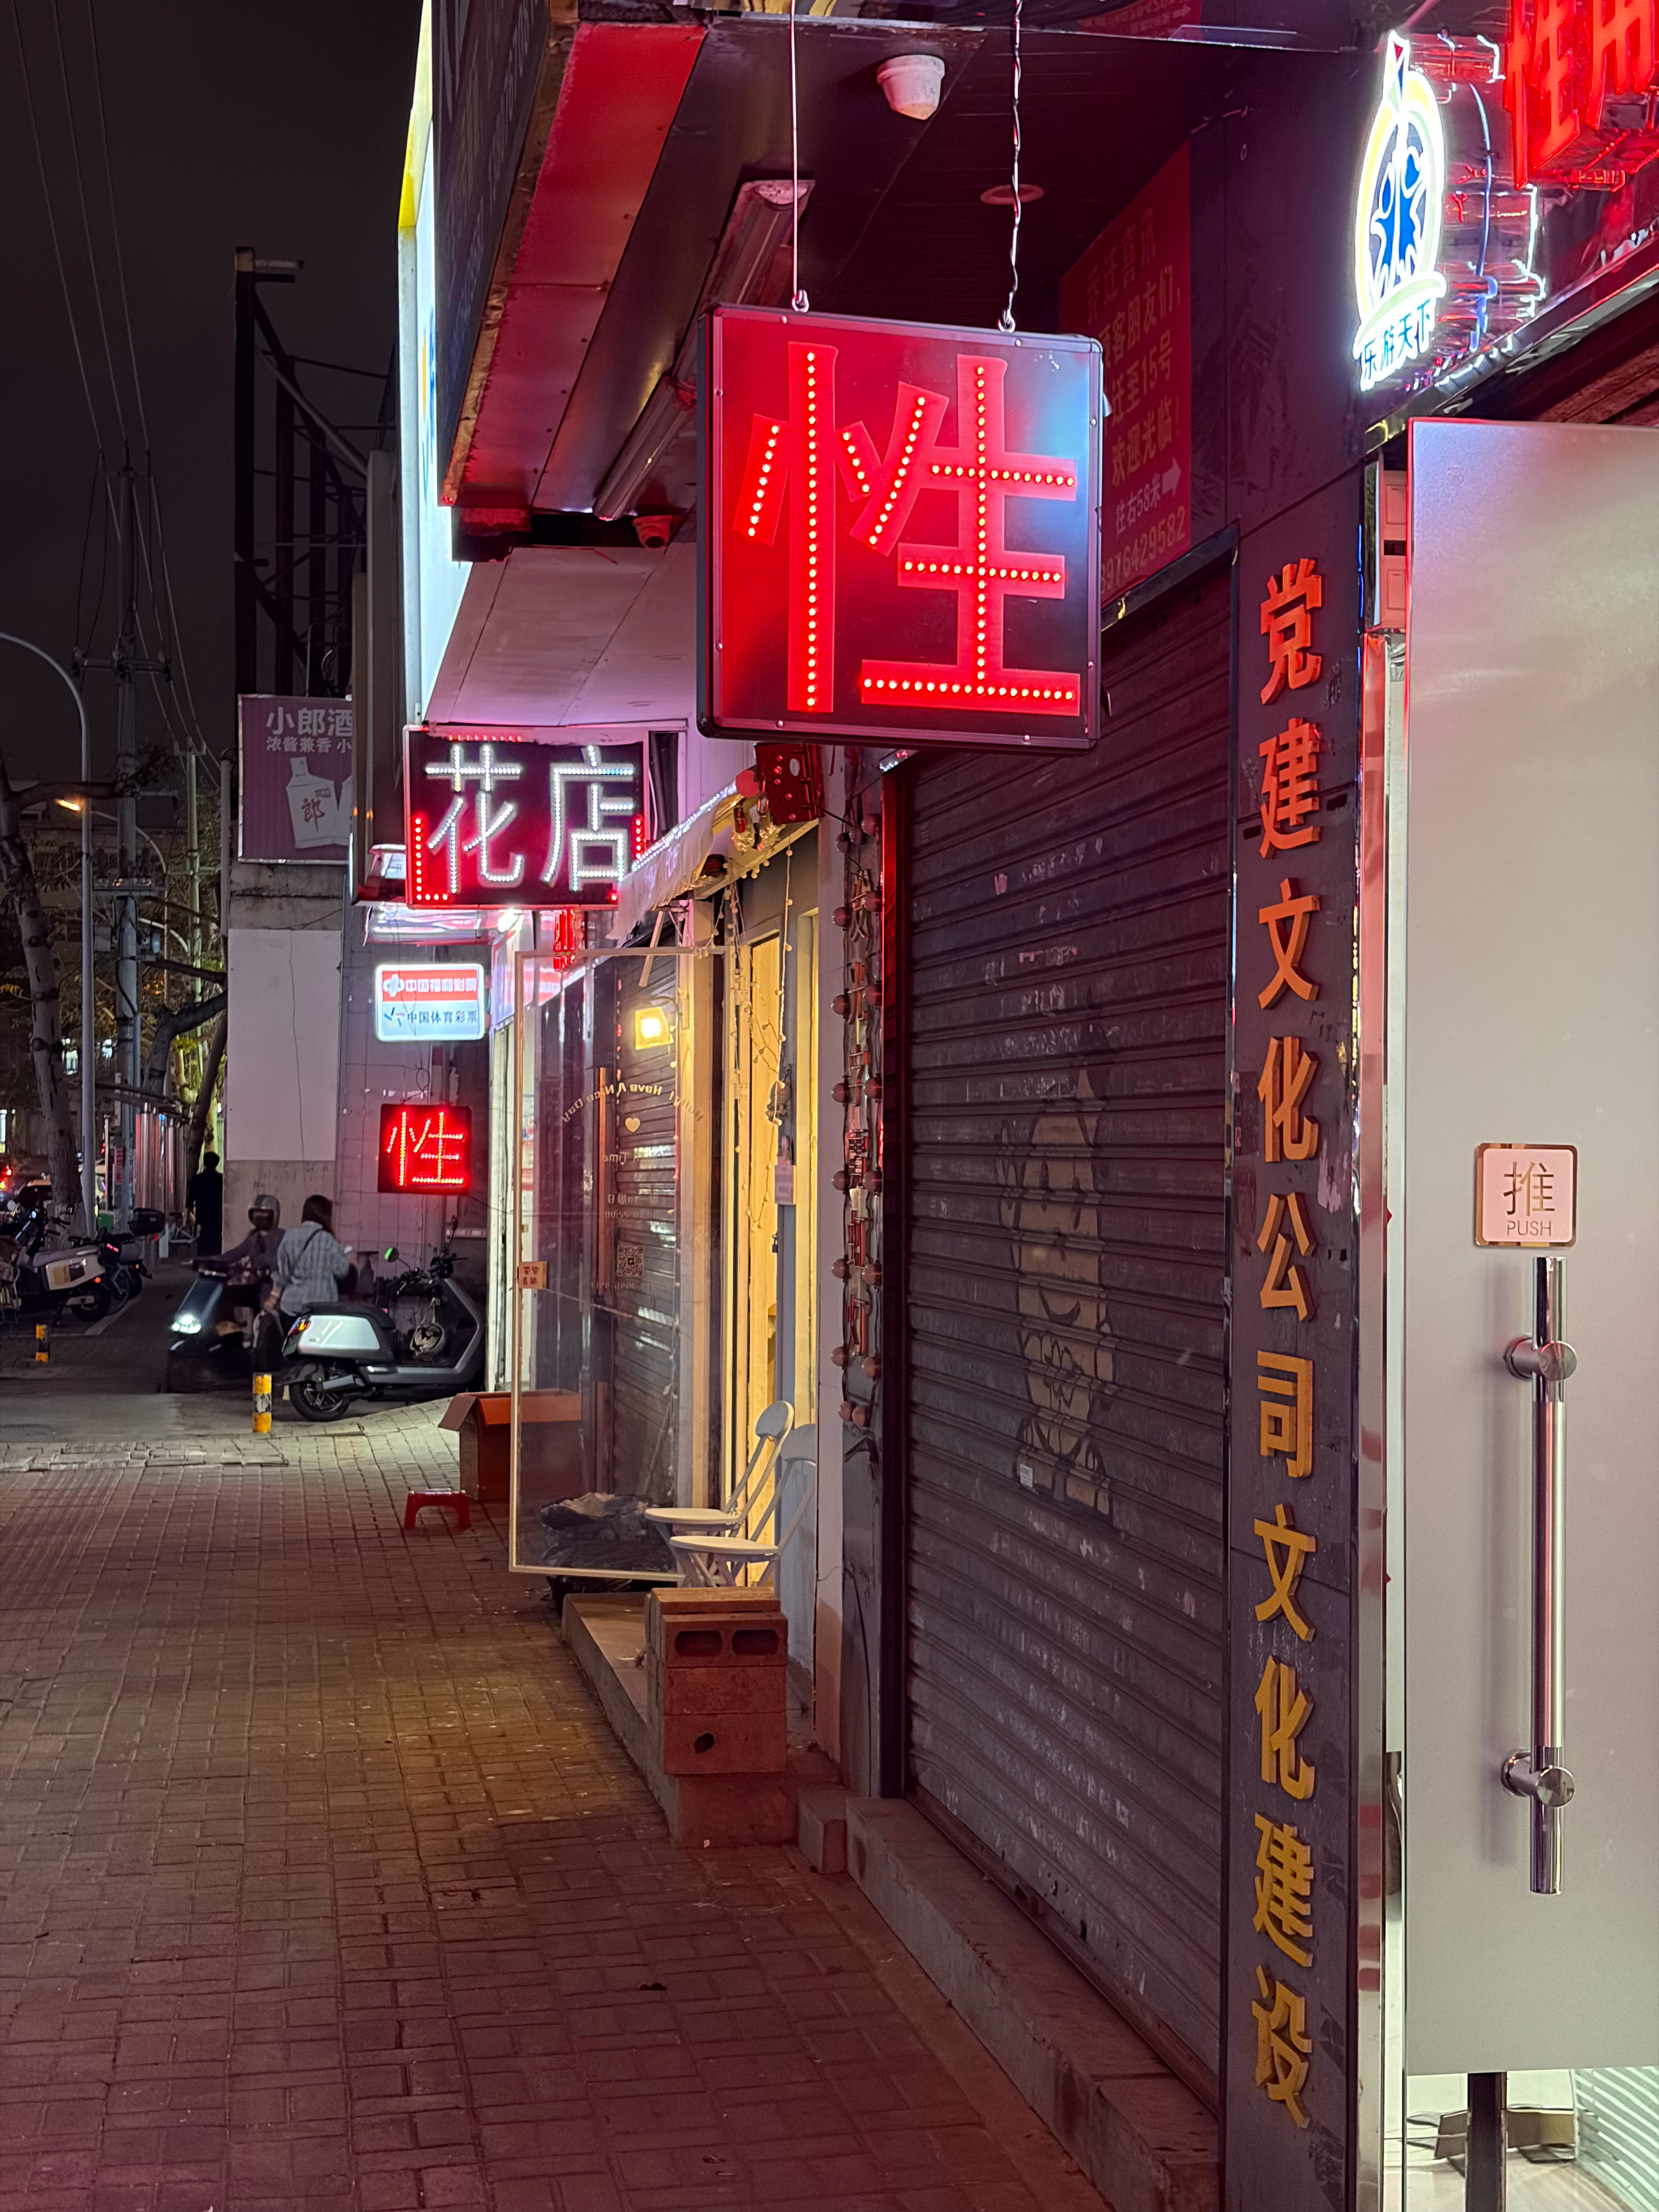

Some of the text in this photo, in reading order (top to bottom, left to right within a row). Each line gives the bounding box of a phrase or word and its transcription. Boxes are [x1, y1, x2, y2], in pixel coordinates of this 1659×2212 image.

[1363, 298, 1431, 380] 乐游天下
[732, 341, 1081, 717] 性
[266, 707, 352, 737] 小郎酒
[266, 737, 332, 754] 浓酱兼香
[424, 742, 636, 895] 花店
[405, 978, 477, 992] 中国福利彩票
[407, 1011, 477, 1024] 中国体育彩票
[386, 1110, 465, 1187] 性
[1503, 1161, 1555, 1217] 推
[1506, 1221, 1551, 1236] PUSH
[1251, 556, 1323, 2130] 党建文化公司文化建设
